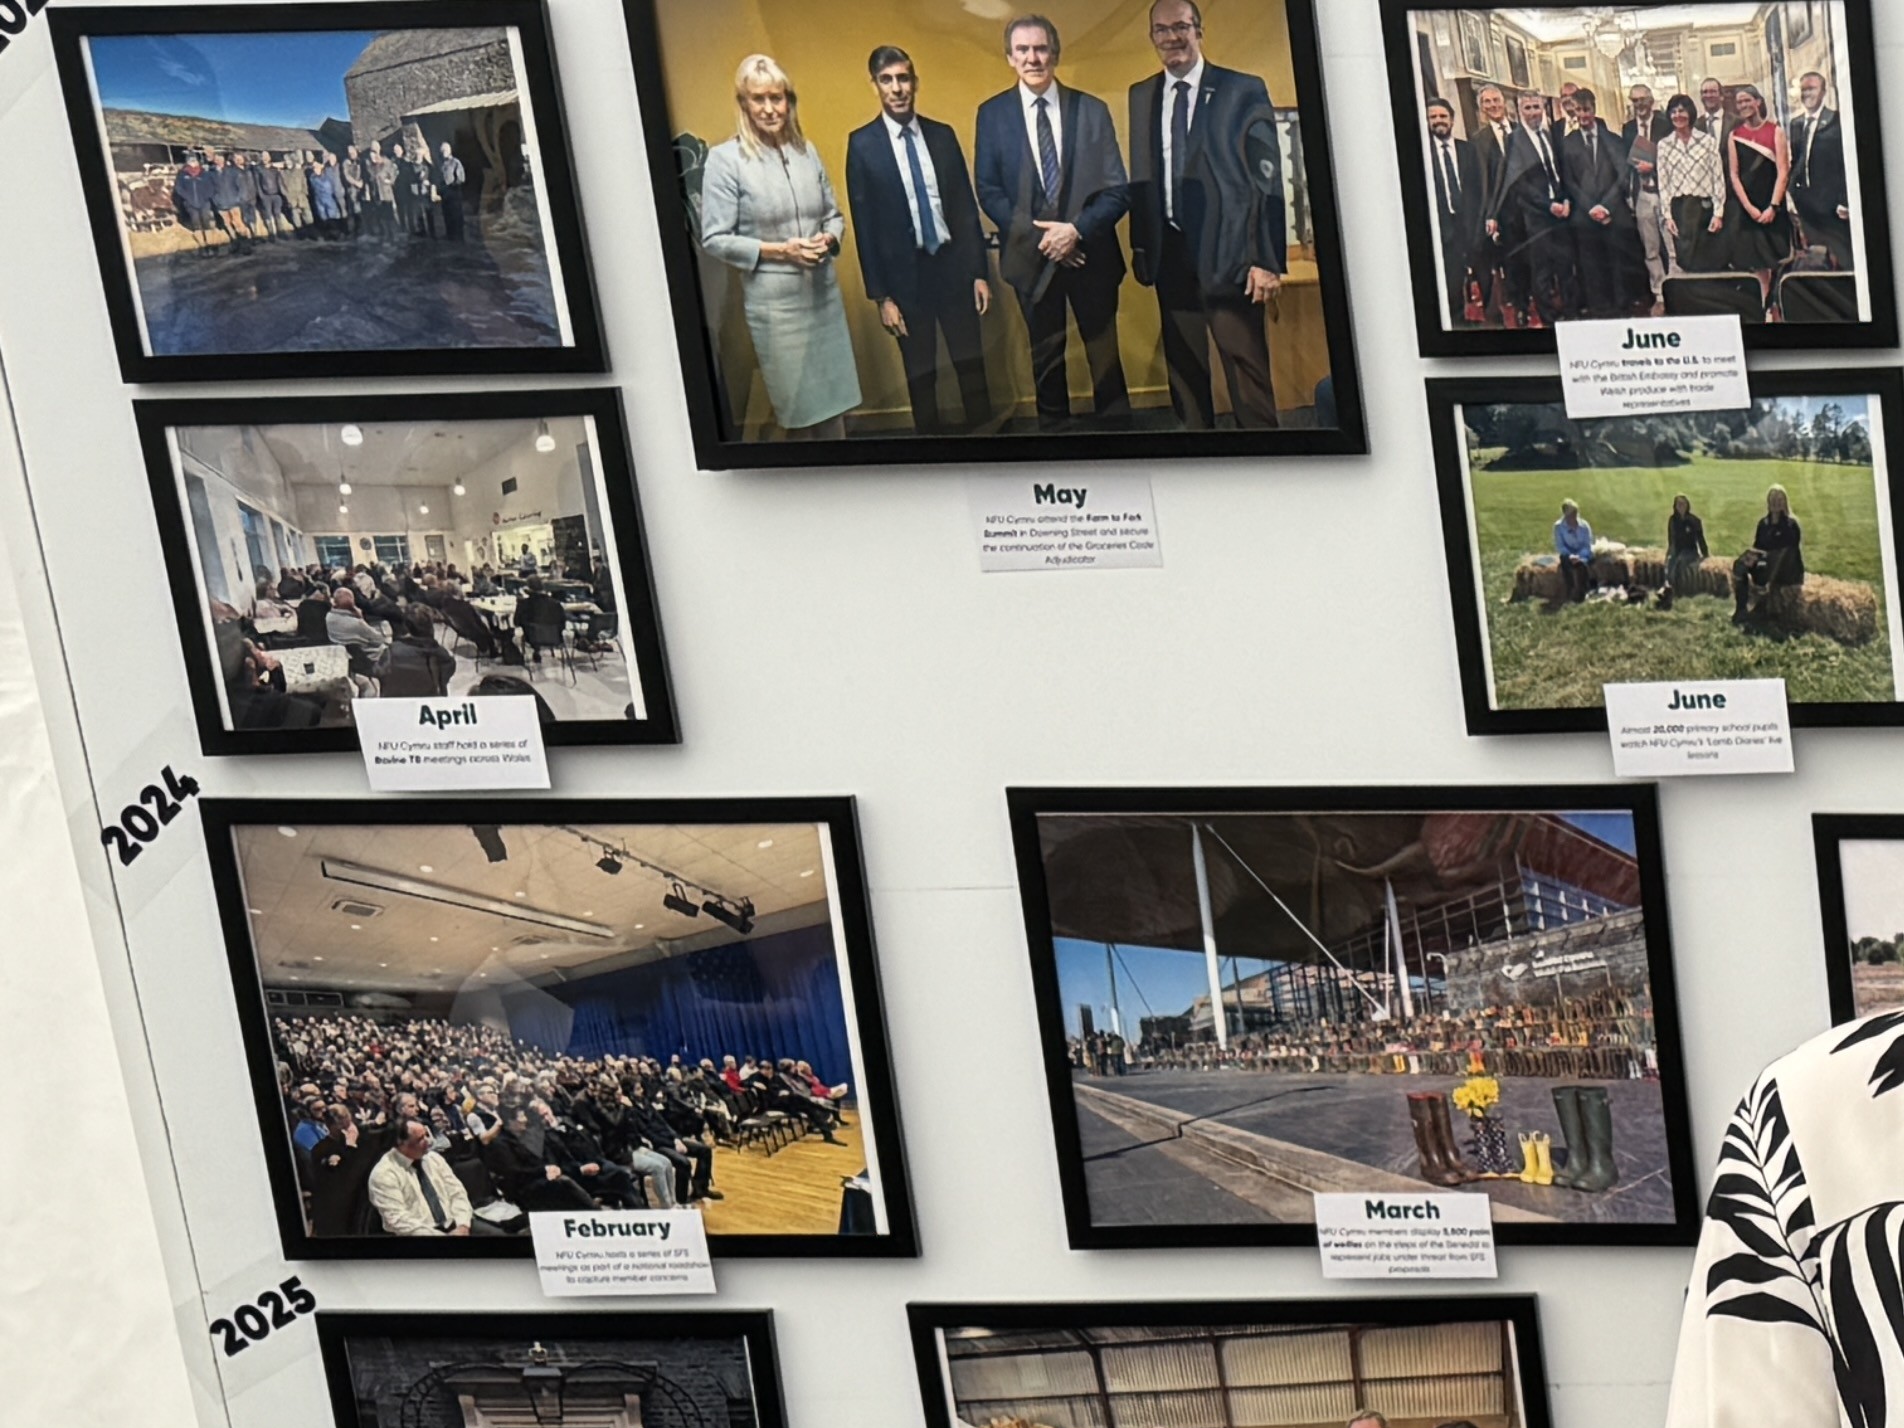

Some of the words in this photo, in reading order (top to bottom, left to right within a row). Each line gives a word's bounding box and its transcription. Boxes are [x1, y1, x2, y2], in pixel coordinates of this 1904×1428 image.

[1622, 329, 1681, 350] June
[1034, 483, 1087, 508] May
[1086, 513, 1108, 522] Farm
[1668, 690, 1726, 710] June
[419, 704, 478, 729] April
[101, 766, 201, 866] 2024
[1365, 1200, 1440, 1219] March
[564, 1218, 670, 1240] February
[210, 1275, 317, 1356] 2025
